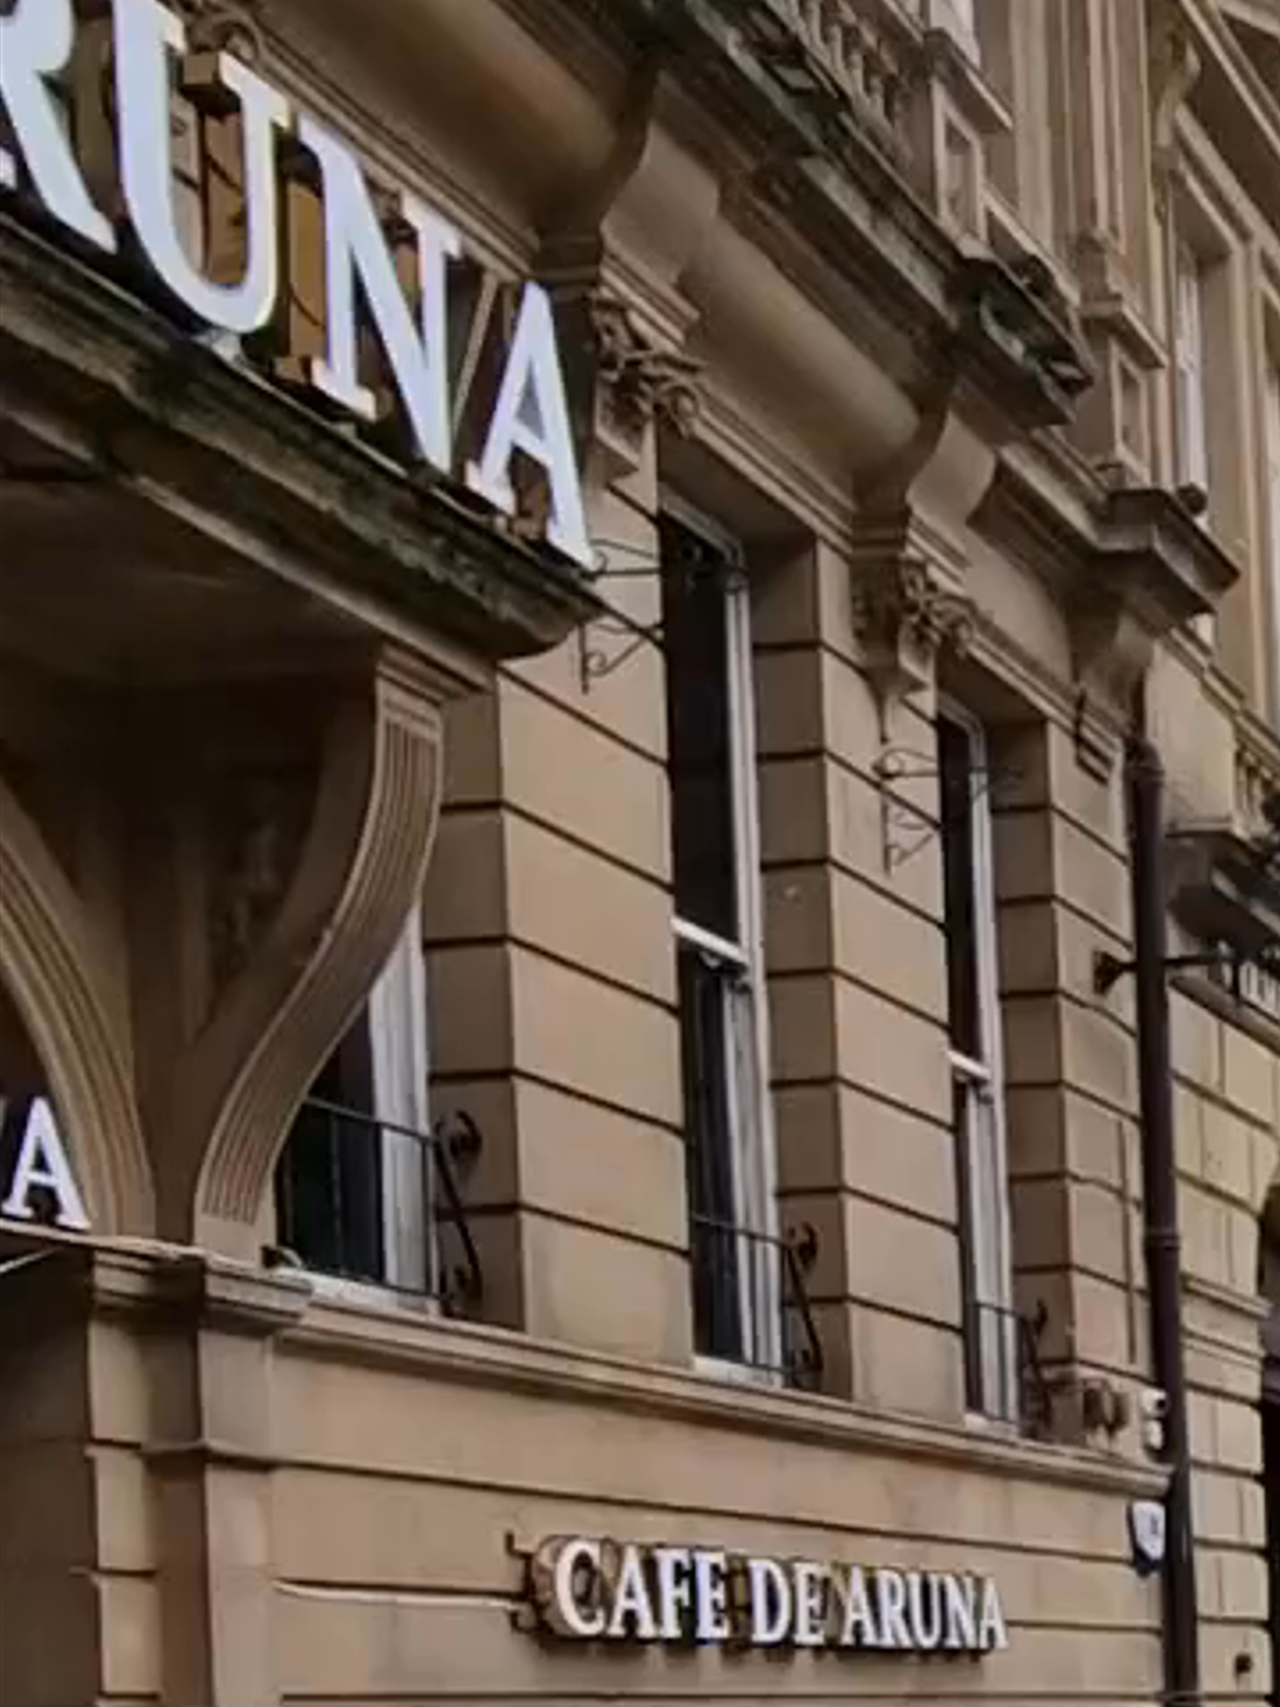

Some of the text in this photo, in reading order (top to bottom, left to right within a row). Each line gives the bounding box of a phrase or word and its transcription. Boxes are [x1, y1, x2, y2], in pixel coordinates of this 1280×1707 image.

[0, 1095, 91, 1230] A
[555, 1539, 1008, 1649] CAFE DE ARUNA
